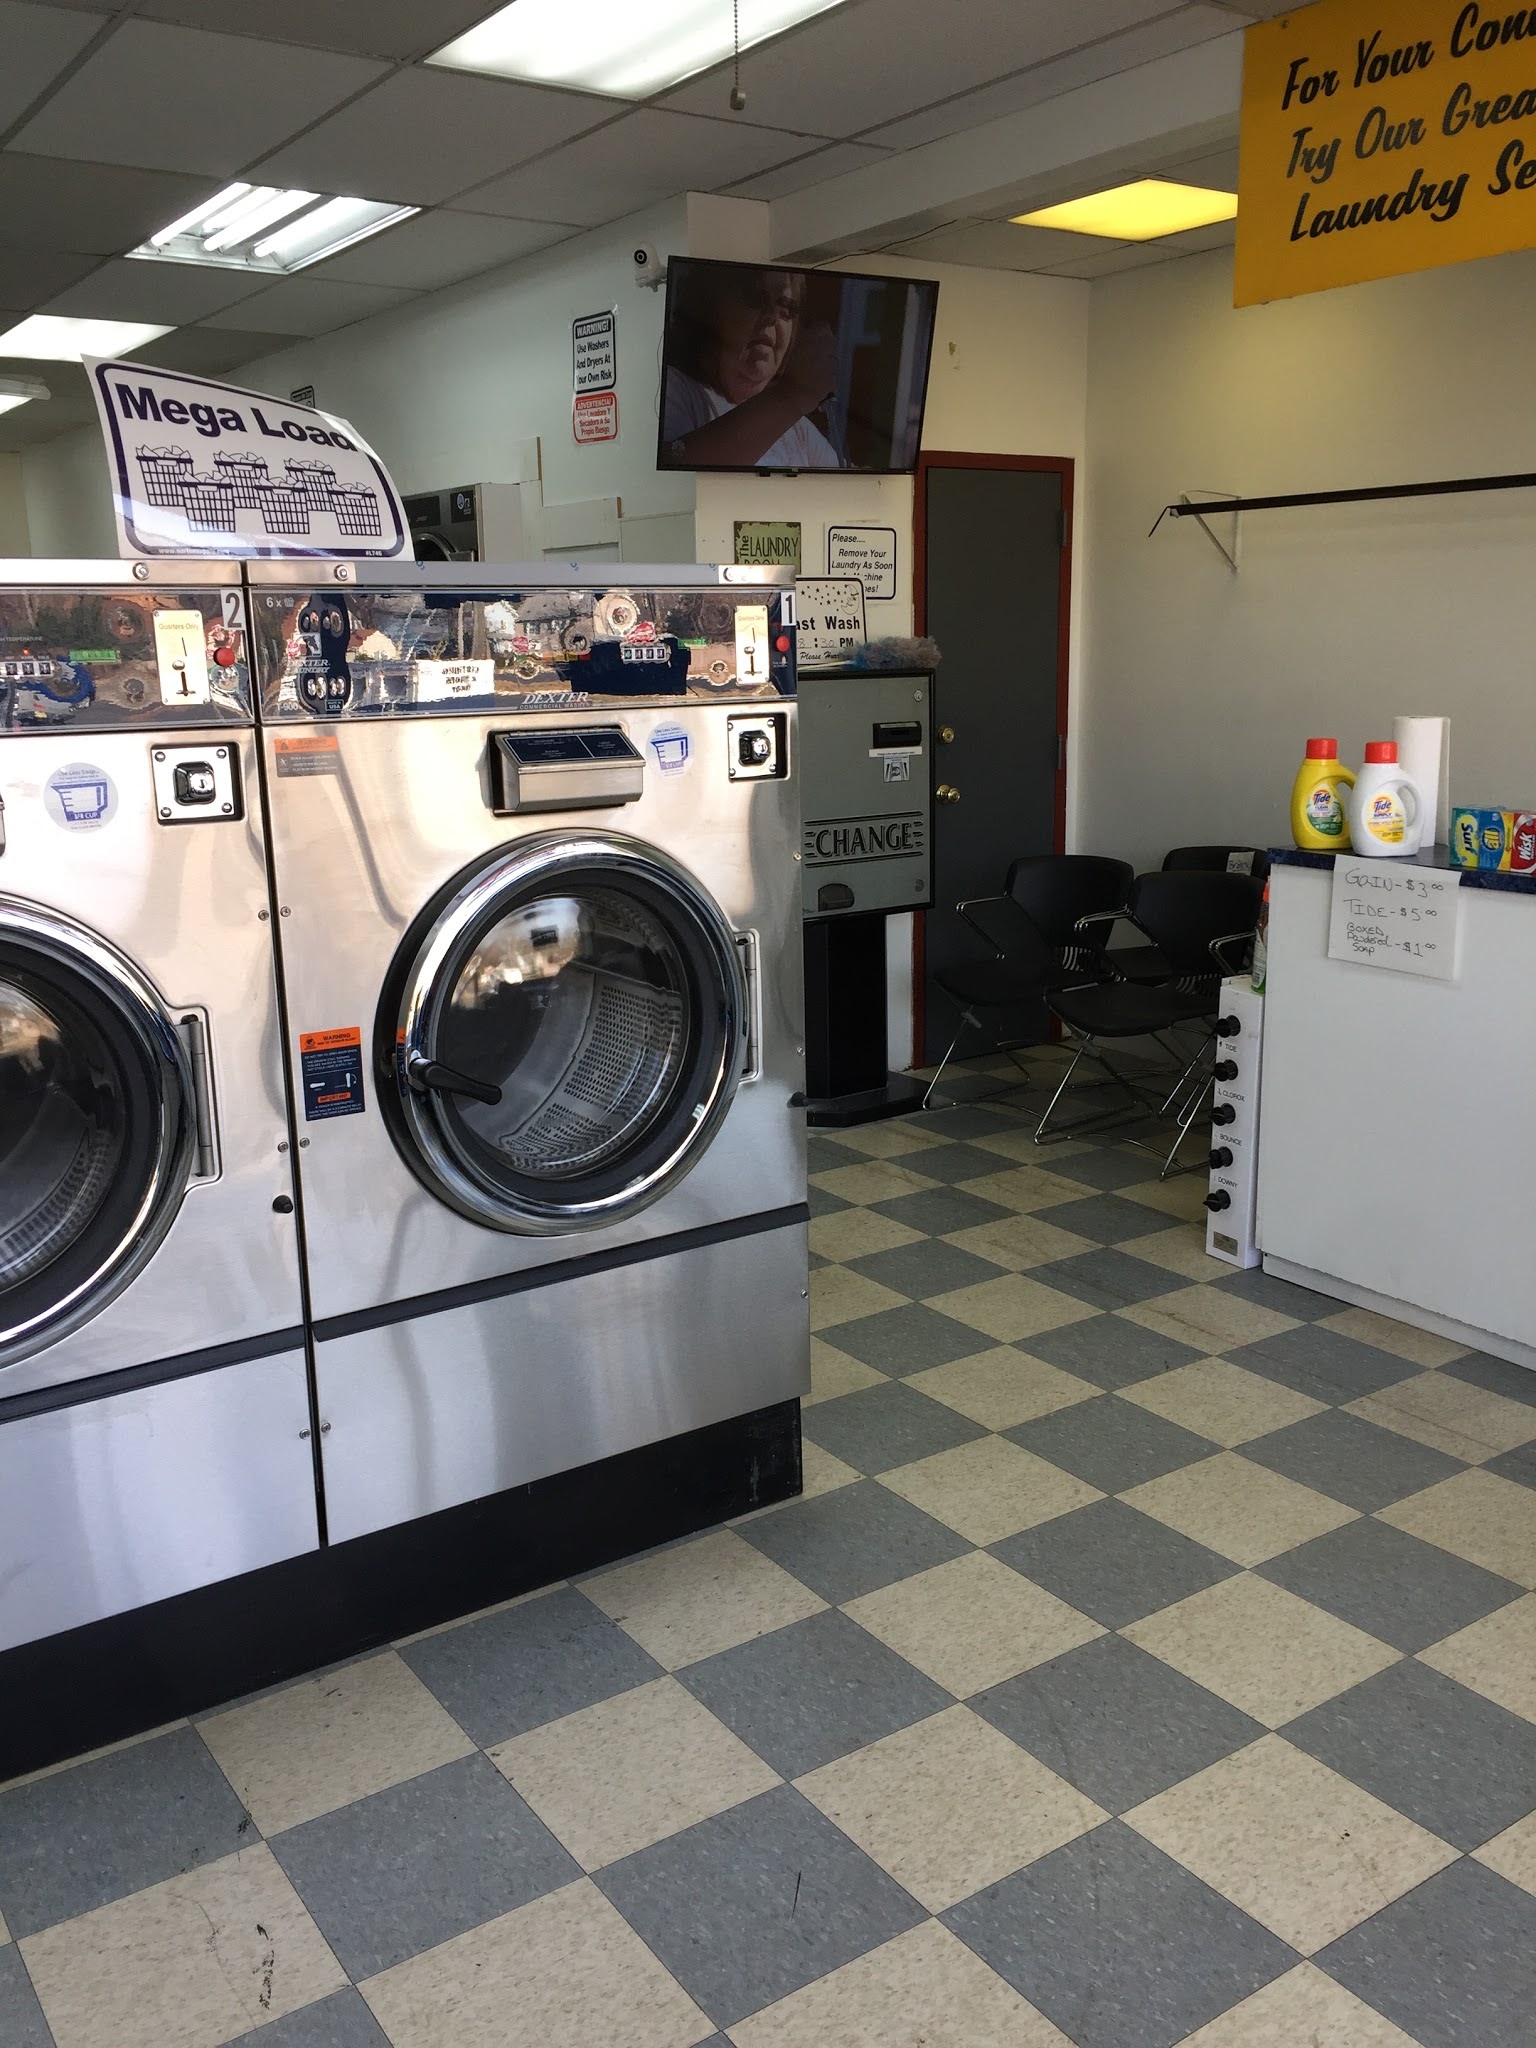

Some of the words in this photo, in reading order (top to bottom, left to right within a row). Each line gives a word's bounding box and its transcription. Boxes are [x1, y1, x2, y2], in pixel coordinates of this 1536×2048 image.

[1281, 57, 1340, 110] For
[1353, 30, 1435, 88] Your
[1286, 126, 1342, 184] Try
[1355, 106, 1427, 159] Our
[1290, 168, 1470, 242] Laundry
[577, 320, 610, 337] WARNING!
[587, 340, 610, 352] Washers
[587, 358, 604, 370] Dryers
[605, 354, 611, 364] At
[588, 372, 600, 383] Own
[601, 369, 612, 380] Risk
[114, 383, 247, 438] Mega
[250, 407, 358, 452] Load
[740, 535, 749, 558] The
[750, 537, 799, 557] LAUNDRY
[839, 549, 868, 558] Remove
[870, 549, 887, 558] Your
[832, 561, 862, 571] Laundry
[863, 561, 873, 570] As
[874, 561, 893, 570] Soon
[266, 597, 274, 608] 6
[276, 600, 282, 608] x
[784, 594, 793, 624] 1
[225, 592, 242, 628] 2
[159, 623, 185, 631] Quarters
[186, 623, 200, 631] Only
[796, 617, 816, 630] ast
[825, 616, 860, 630] Wash
[840, 637, 854, 648] PM
[800, 651, 822, 661] Please
[824, 651, 841, 660] Hurr
[522, 692, 589, 705] DEXTER
[1313, 793, 1331, 806] Tide
[1374, 800, 1392, 813] Tide
[815, 821, 914, 858] CHANGE
[1461, 823, 1479, 856] Surf
[1484, 830, 1500, 850] all
[1225, 1043, 1237, 1053] TIDE
[1223, 1090, 1245, 1102] CLOROX
[1220, 1133, 1242, 1147] BOUNCE
[1218, 1176, 1238, 1189] DOWNY
